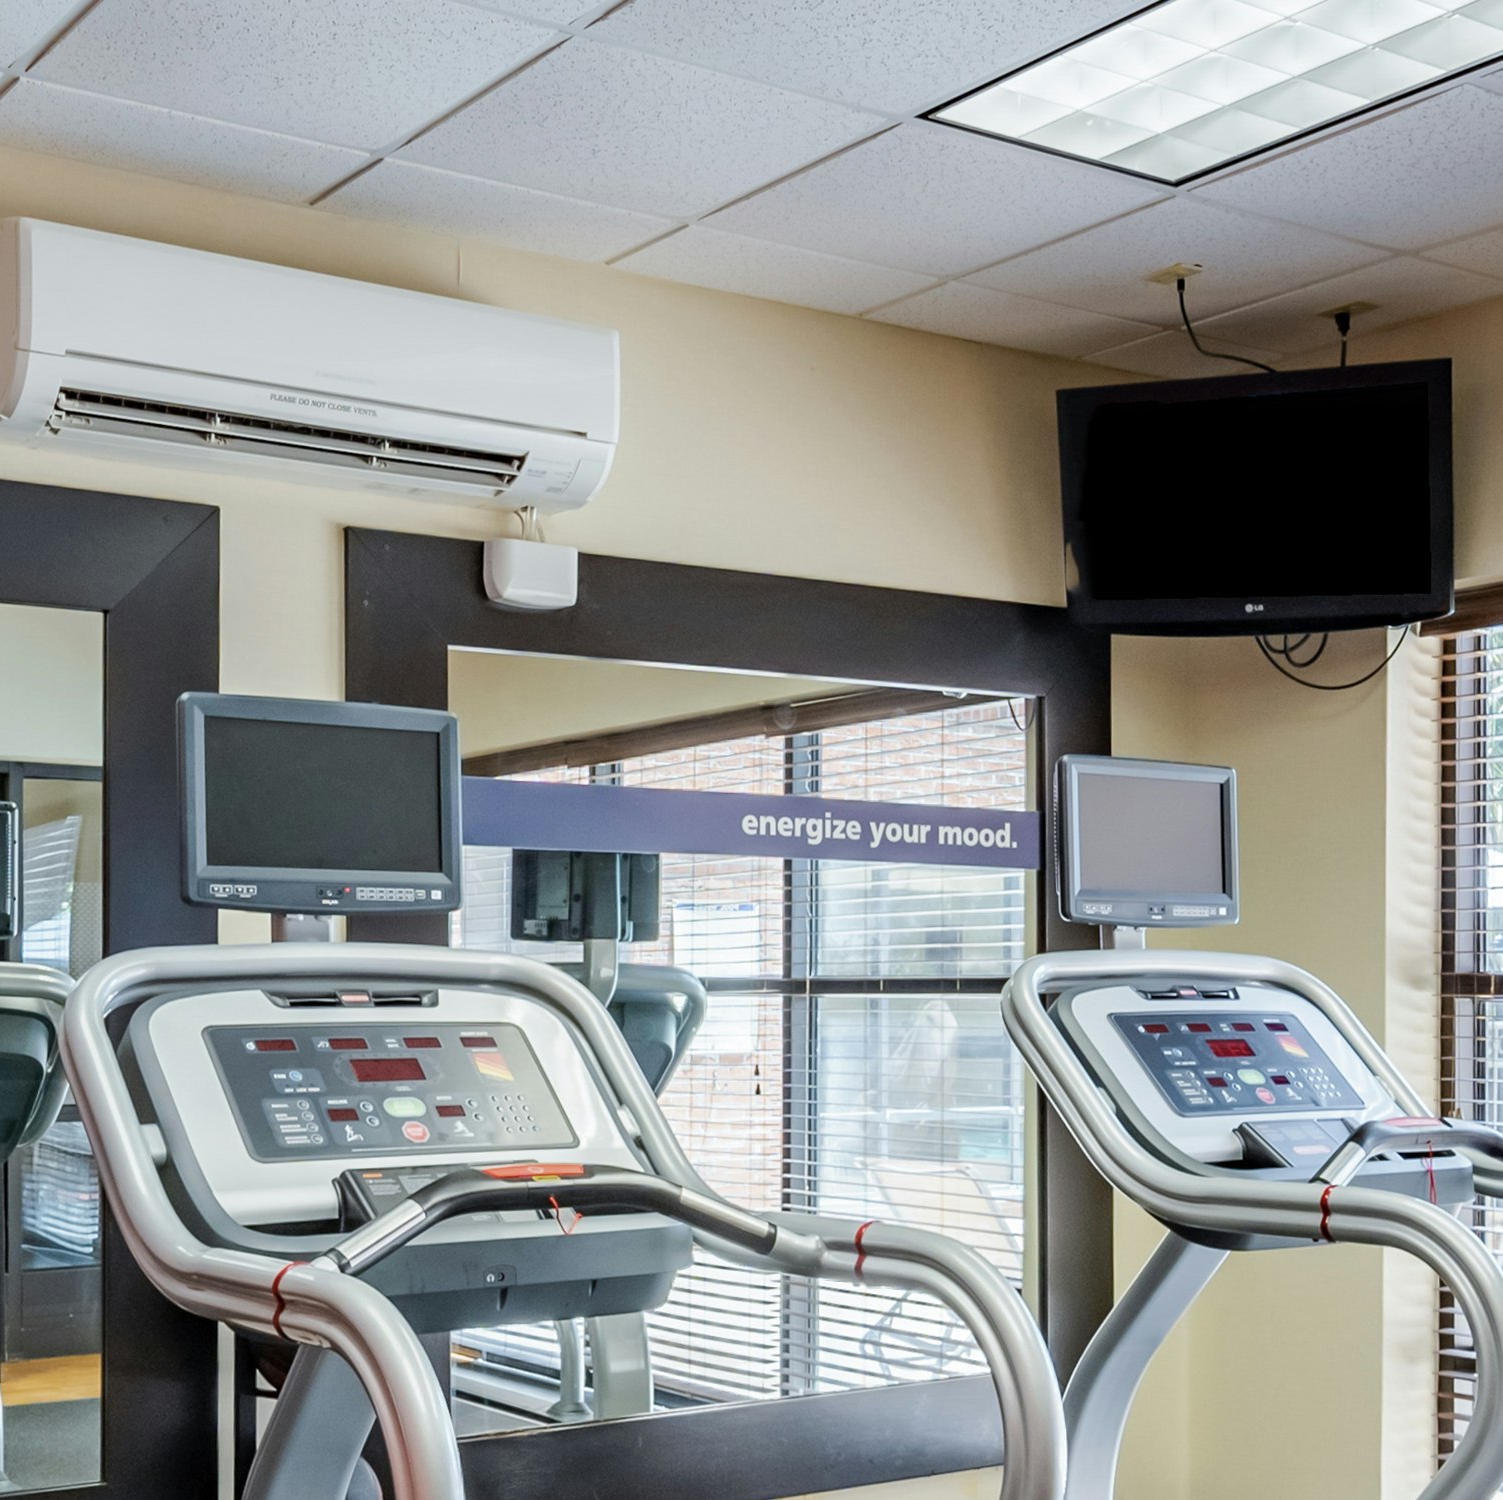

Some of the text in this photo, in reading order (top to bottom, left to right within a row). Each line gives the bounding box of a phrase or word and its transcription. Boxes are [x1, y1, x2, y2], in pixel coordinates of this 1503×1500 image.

[269, 393, 297, 404] PLEASE
[298, 398, 310, 406] DO
[311, 400, 326, 408] NOT
[327, 402, 352, 412] CLOSE
[741, 811, 1017, 849] energize your mood.
